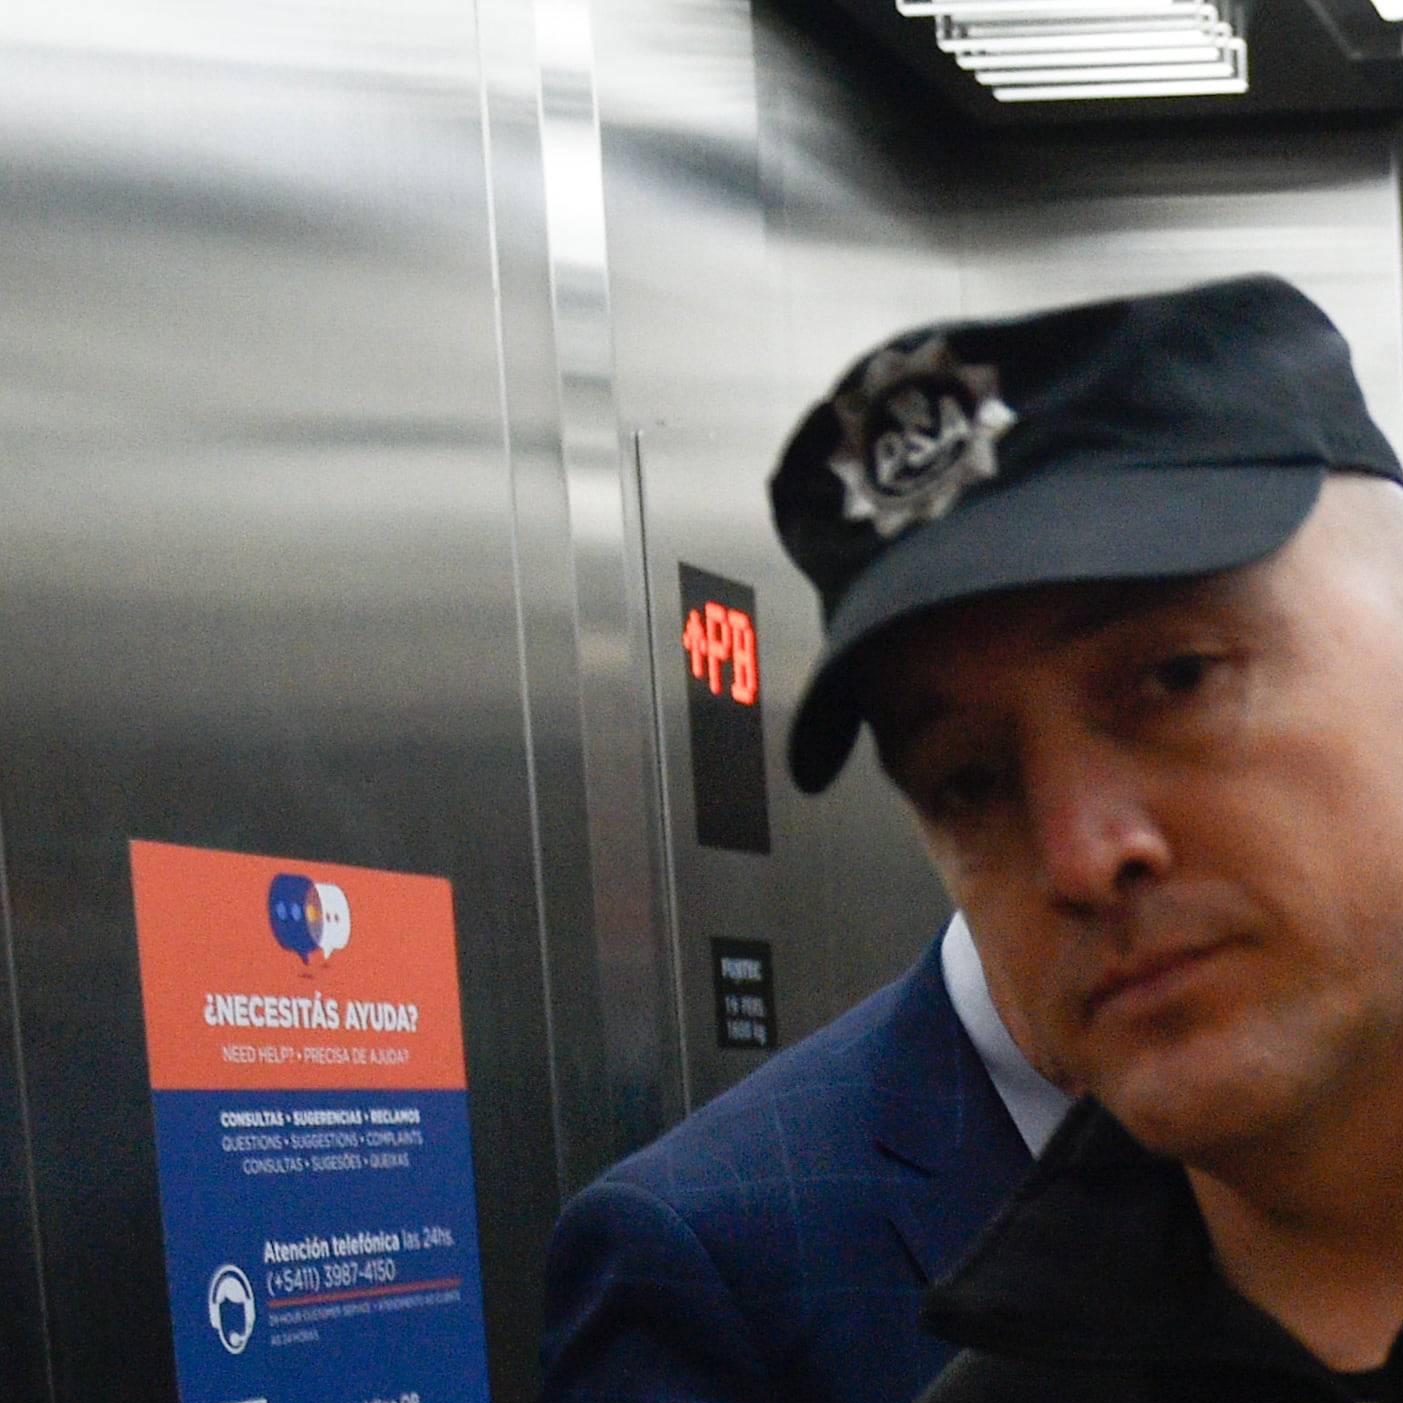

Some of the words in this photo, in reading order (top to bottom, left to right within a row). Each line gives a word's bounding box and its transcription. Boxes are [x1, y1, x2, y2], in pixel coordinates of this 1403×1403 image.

[704, 598, 757, 706] PB
[204, 990, 340, 1029] ¿NECESITÁS
[345, 1001, 420, 1032] AYUDA?
[222, 1045, 256, 1064] NEED
[259, 1046, 294, 1064] HELP?
[303, 1047, 350, 1064] PRECISA
[353, 1048, 367, 1065] DE
[370, 1049, 410, 1066] AJUDA?
[220, 1111, 284, 1127] CONSULTAS
[293, 1110, 362, 1126] SUGERENCIAS
[370, 1109, 421, 1125] RECLAMOS
[221, 1134, 283, 1152] QUESTIONS
[291, 1132, 359, 1150] SUGGESTIONS
[366, 1130, 424, 1147] COMPLAINTS
[242, 1157, 304, 1174] CONSULTAS
[264, 1236, 330, 1264] Atención
[332, 1231, 400, 1257] telefónica
[402, 1229, 420, 1250] las
[266, 1265, 320, 1297] (+5411)
[324, 1258, 396, 1288] 3987-4150
